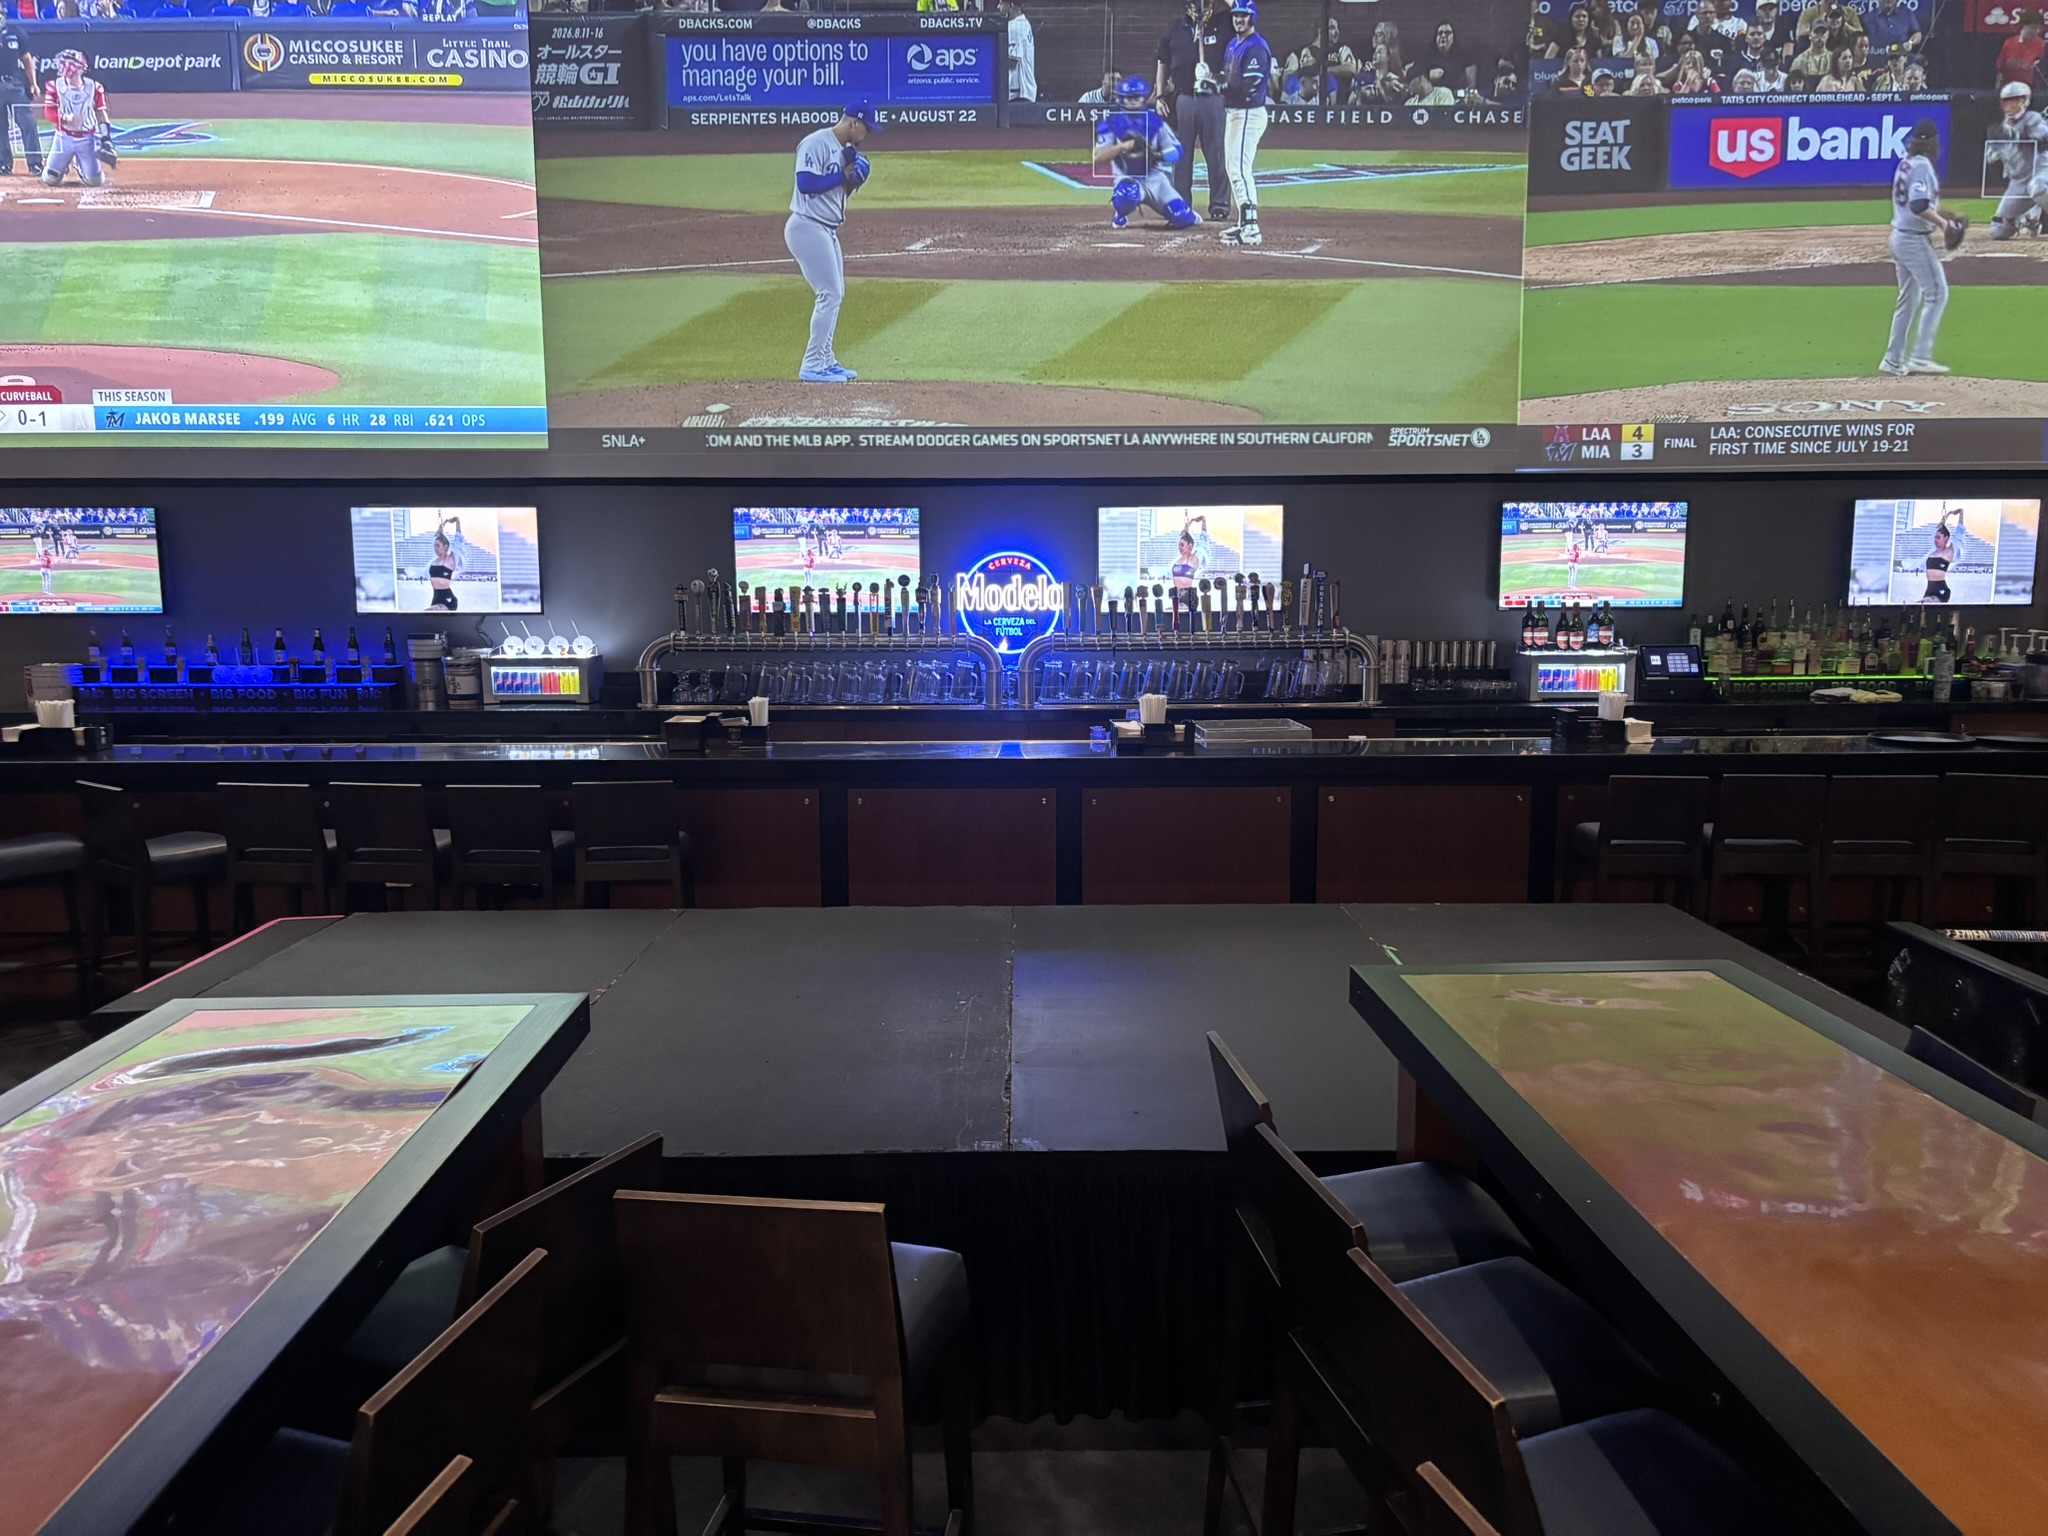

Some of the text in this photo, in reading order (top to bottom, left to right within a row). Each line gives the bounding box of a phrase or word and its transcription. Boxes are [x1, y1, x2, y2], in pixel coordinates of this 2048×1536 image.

[422, 14, 458, 23] REPLAY
[678, 17, 983, 30] DBACKS.COM @DBACKS DBACKS.TV
[551, 27, 604, 39] 2026.8.11-16
[288, 39, 404, 54] MICCOSUKEE
[442, 38, 512, 48] LITTLE TRAIL
[426, 48, 530, 69] CASINO
[536, 44, 623, 60] オールスター
[681, 37, 869, 68] you have options to
[94, 53, 222, 71] loanDepot park
[289, 53, 404, 66] CASINO & RESORT
[934, 48, 978, 71] aps
[322, 75, 449, 84] MICCOSUKEE.COM
[682, 62, 845, 93] manage your bill.
[1720, 95, 1745, 105] TATIS
[1746, 95, 1766, 104] CITY
[1766, 94, 1808, 104] CONNECT
[1808, 93, 1866, 103] BOBBLEHEAD
[1871, 93, 1892, 103] SEPT
[690, 112, 777, 126] SERPIENTES
[780, 111, 840, 124] HABOOB
[898, 110, 956, 123] AUGUST
[957, 109, 977, 122] 22
[1326, 110, 1394, 124] FIELD
[1453, 110, 1523, 123] CHASE
[1564, 119, 1631, 146] SEAT
[1717, 115, 1913, 163] us bank
[1560, 145, 1632, 172] GEEK
[0, 391, 53, 402] CURVEBALL
[98, 391, 166, 402] THIS SEASON
[17, 409, 47, 427] 0-1
[135, 412, 486, 427] JAKOB MARSEE .199 AVG 6 HR 28 RBI .621 OPS
[1390, 427, 1430, 436] SPECTRUM
[1581, 426, 1644, 441] LAA 4
[1710, 423, 1916, 440] LAA: CONSECUTIVE WINS FOR
[601, 434, 647, 448] SNLA+
[734, 434, 763, 447] AND
[765, 434, 791, 447] THE
[793, 434, 822, 447] MLB
[824, 434, 855, 447] APP.
[858, 433, 915, 447] STREAM
[916, 433, 971, 447] DODGER
[972, 433, 1019, 446] GAMES
[1021, 433, 1041, 446] ON
[1043, 433, 1122, 446] SPORTSNET
[1123, 432, 1140, 446] LA
[1142, 432, 1218, 446] ANYWHERE
[1220, 432, 1235, 445] IN
[1236, 431, 1310, 445] SOUTHERN
[1387, 434, 1471, 447] SPORTSNET
[1663, 437, 1698, 449] FINAL
[1581, 444, 1643, 460] MIA 3
[1709, 439, 1909, 456] FIRST TIME SINCE JULY 19-21
[988, 557, 1032, 570] CERVEZA
[956, 572, 1064, 612] Modelo
[993, 617, 1025, 626] CERVEZA
[112, 688, 138, 700] BIG
[140, 688, 195, 700] SCREEN
[210, 688, 234, 700] BIG
[237, 688, 277, 700] FOOD
[293, 688, 318, 700] BIG
[319, 688, 348, 700] FUN
[1732, 681, 1755, 694] BIG
[1758, 681, 1814, 693] SCREEN
[1857, 681, 1897, 692] FOOD
